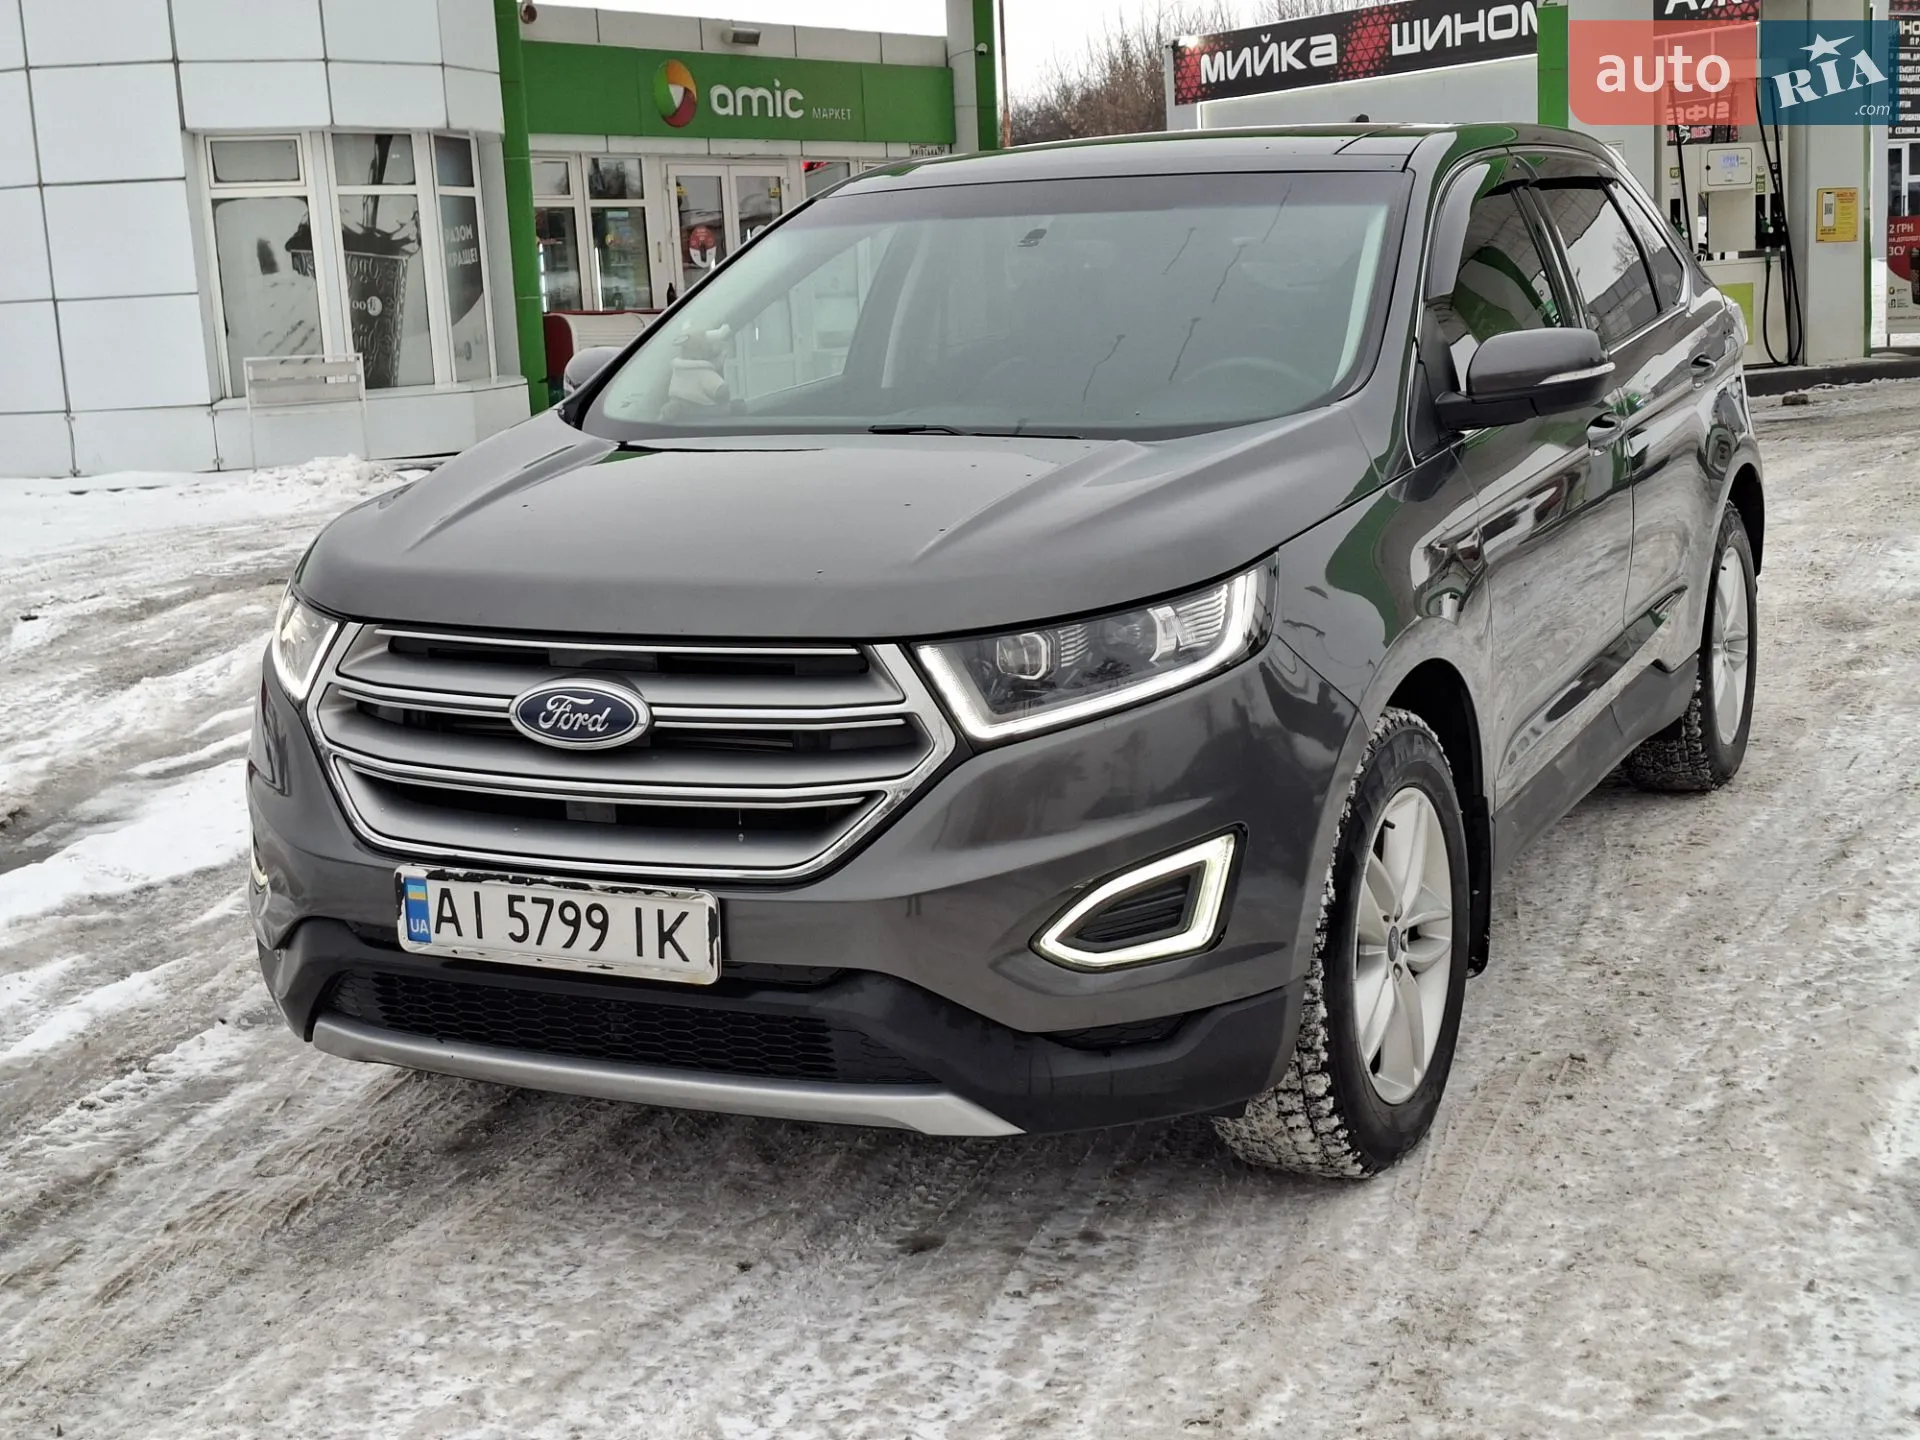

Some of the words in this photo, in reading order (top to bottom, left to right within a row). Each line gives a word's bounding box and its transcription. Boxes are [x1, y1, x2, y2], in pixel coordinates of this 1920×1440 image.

[709, 78, 804, 119] amic
[812, 107, 851, 121] МАРКЕТ
[444, 223, 473, 243] РАЗОМ
[1897, 223, 1914, 233] ГРН
[538, 694, 612, 733] Ford
[410, 918, 430, 934] UA
[506, 893, 610, 952] 5799
[634, 906, 690, 962] IK
